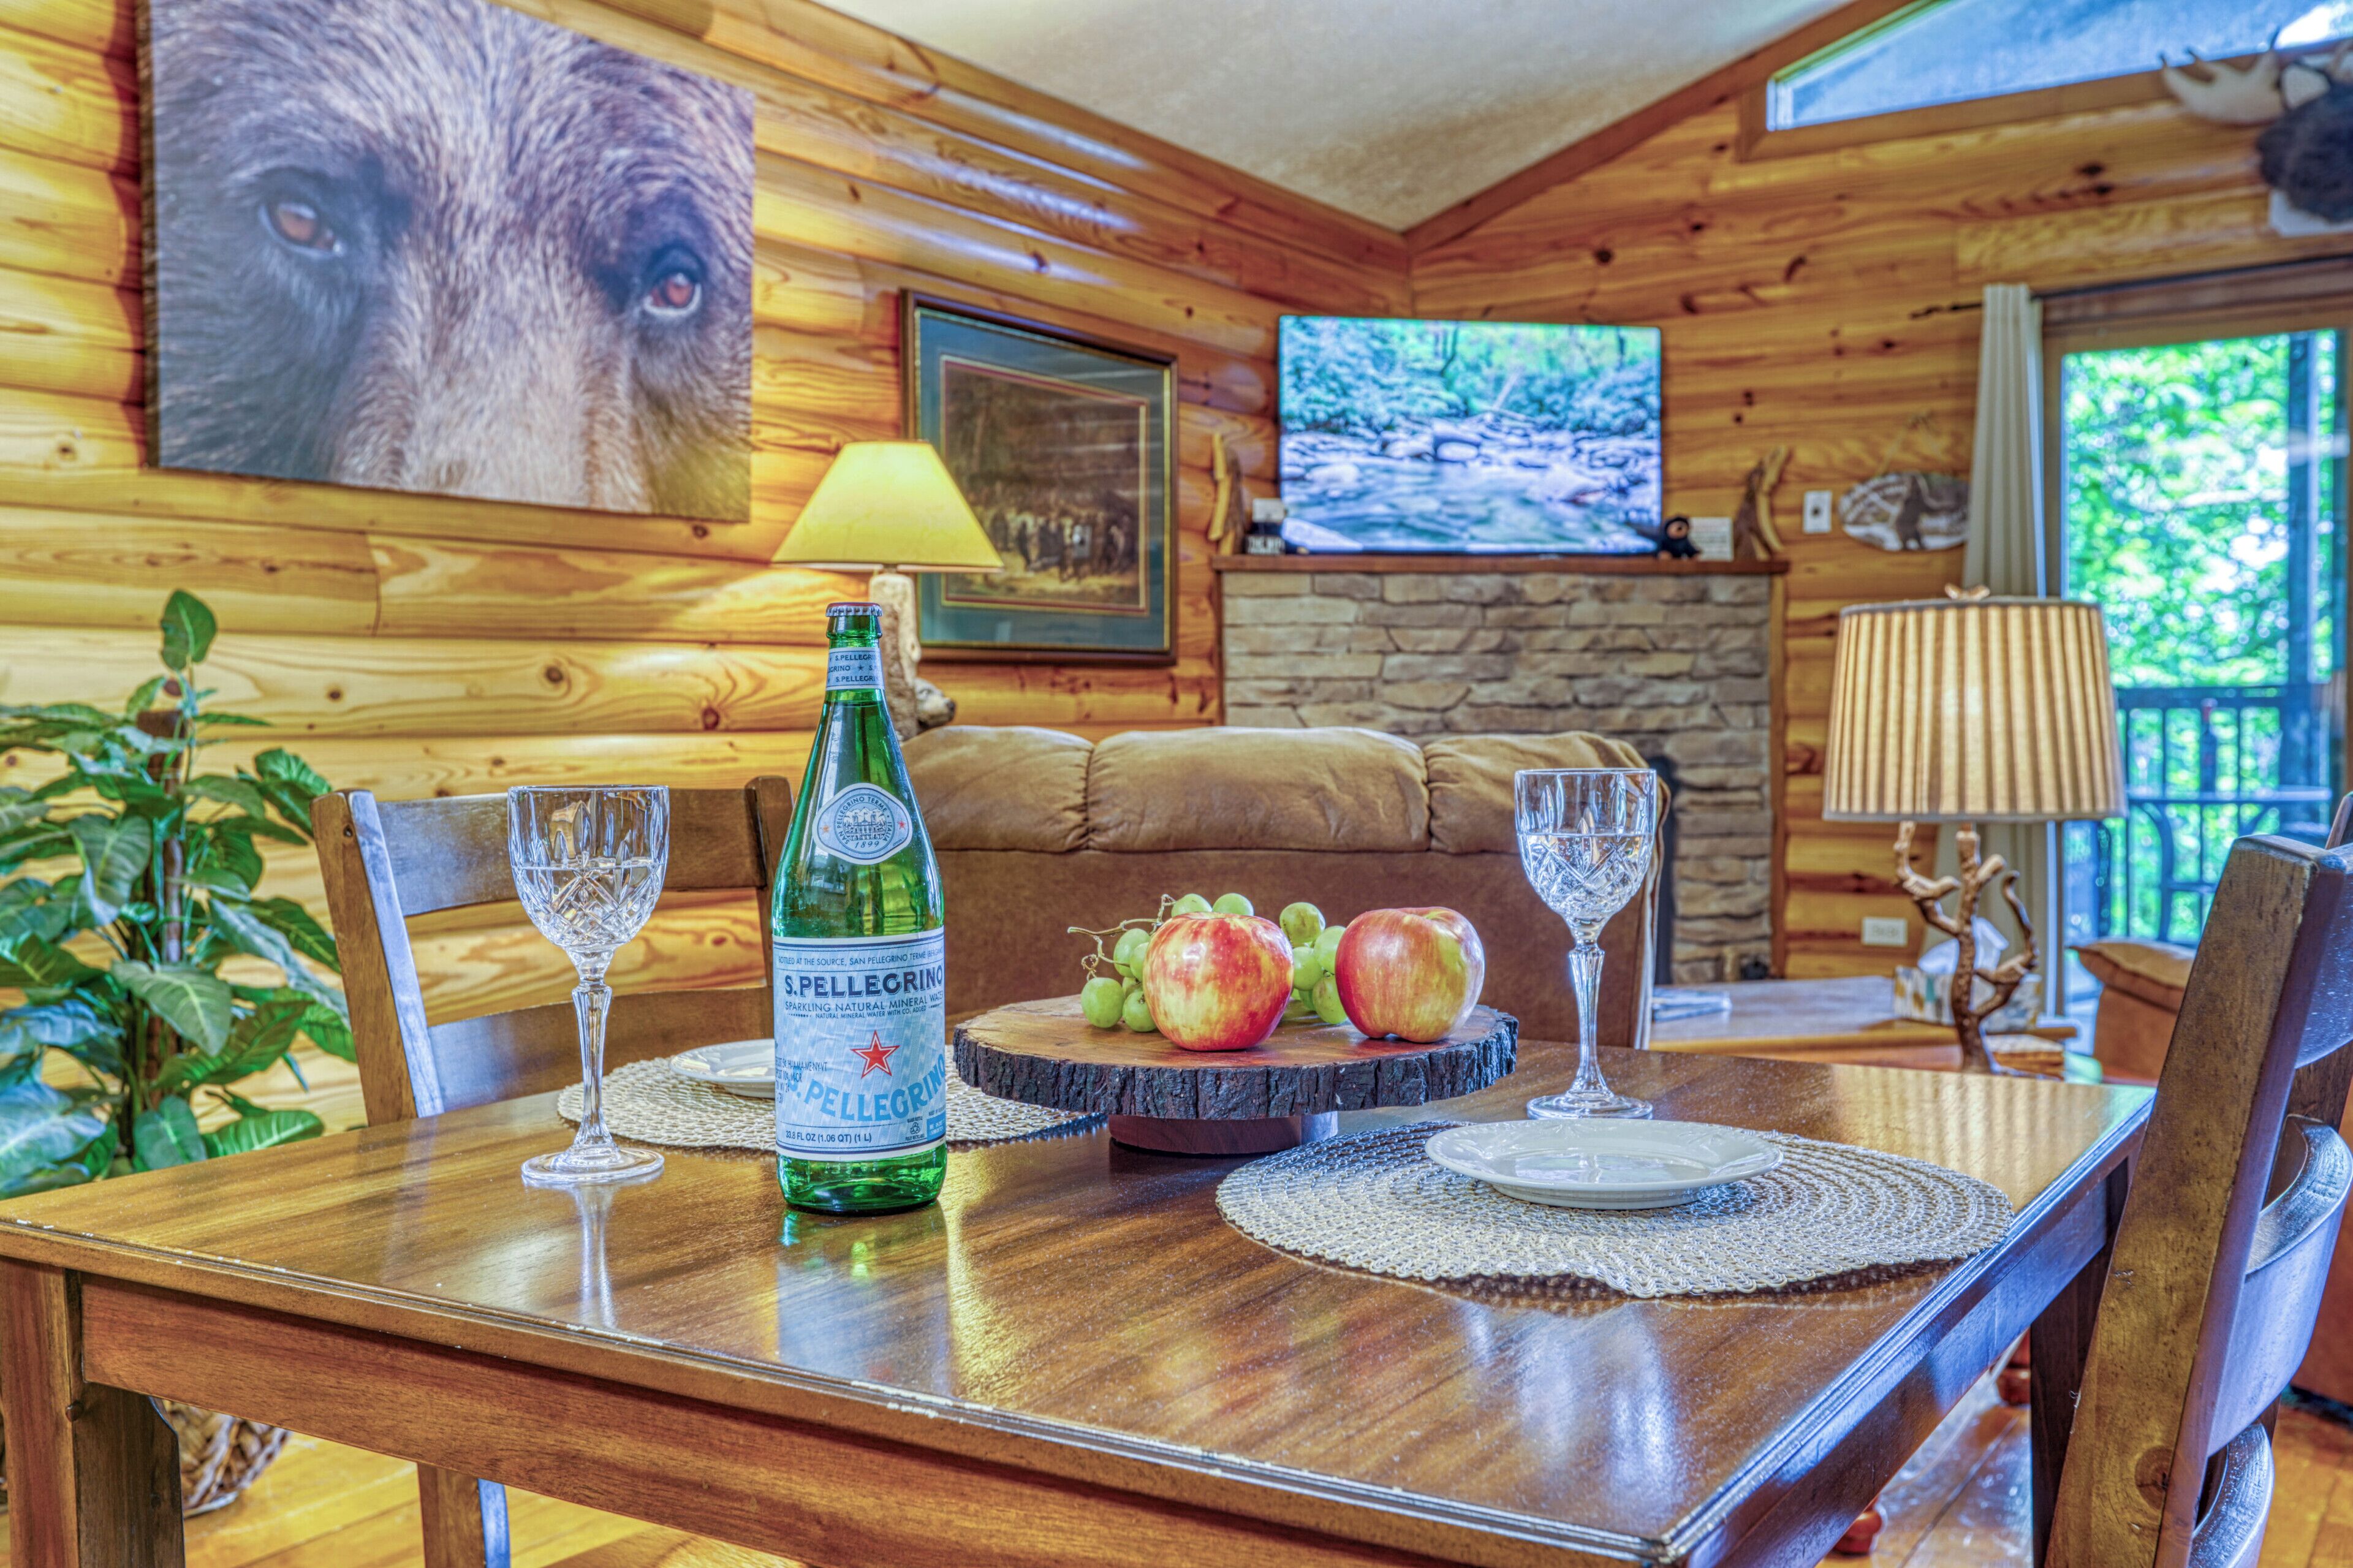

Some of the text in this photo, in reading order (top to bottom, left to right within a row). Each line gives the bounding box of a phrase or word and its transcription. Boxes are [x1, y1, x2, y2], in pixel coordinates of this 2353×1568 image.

[868, 797, 887, 812] TERME
[837, 797, 865, 828] PELLEGRINO
[838, 831, 850, 844] SAN
[882, 822, 892, 842] ITALIA
[854, 840, 880, 849] 1899
[817, 958, 846, 966] SOURCE,
[868, 953, 908, 964] PELLEGRINO
[909, 951, 925, 960] TERME
[784, 963, 942, 998] S.PELLEGRINO
[785, 1001, 830, 1012] SPARKLING
[835, 1001, 885, 1012] NATURAL
[889, 996, 927, 1009] MINERAL
[804, 1053, 945, 1121] PELLEGRINO
[786, 1131, 796, 1140] 33.8
[817, 1134, 835, 1143] (1.06
[838, 1134, 852, 1144] QT)
[854, 1133, 861, 1143] (1
[864, 1132, 872, 1143] L)
